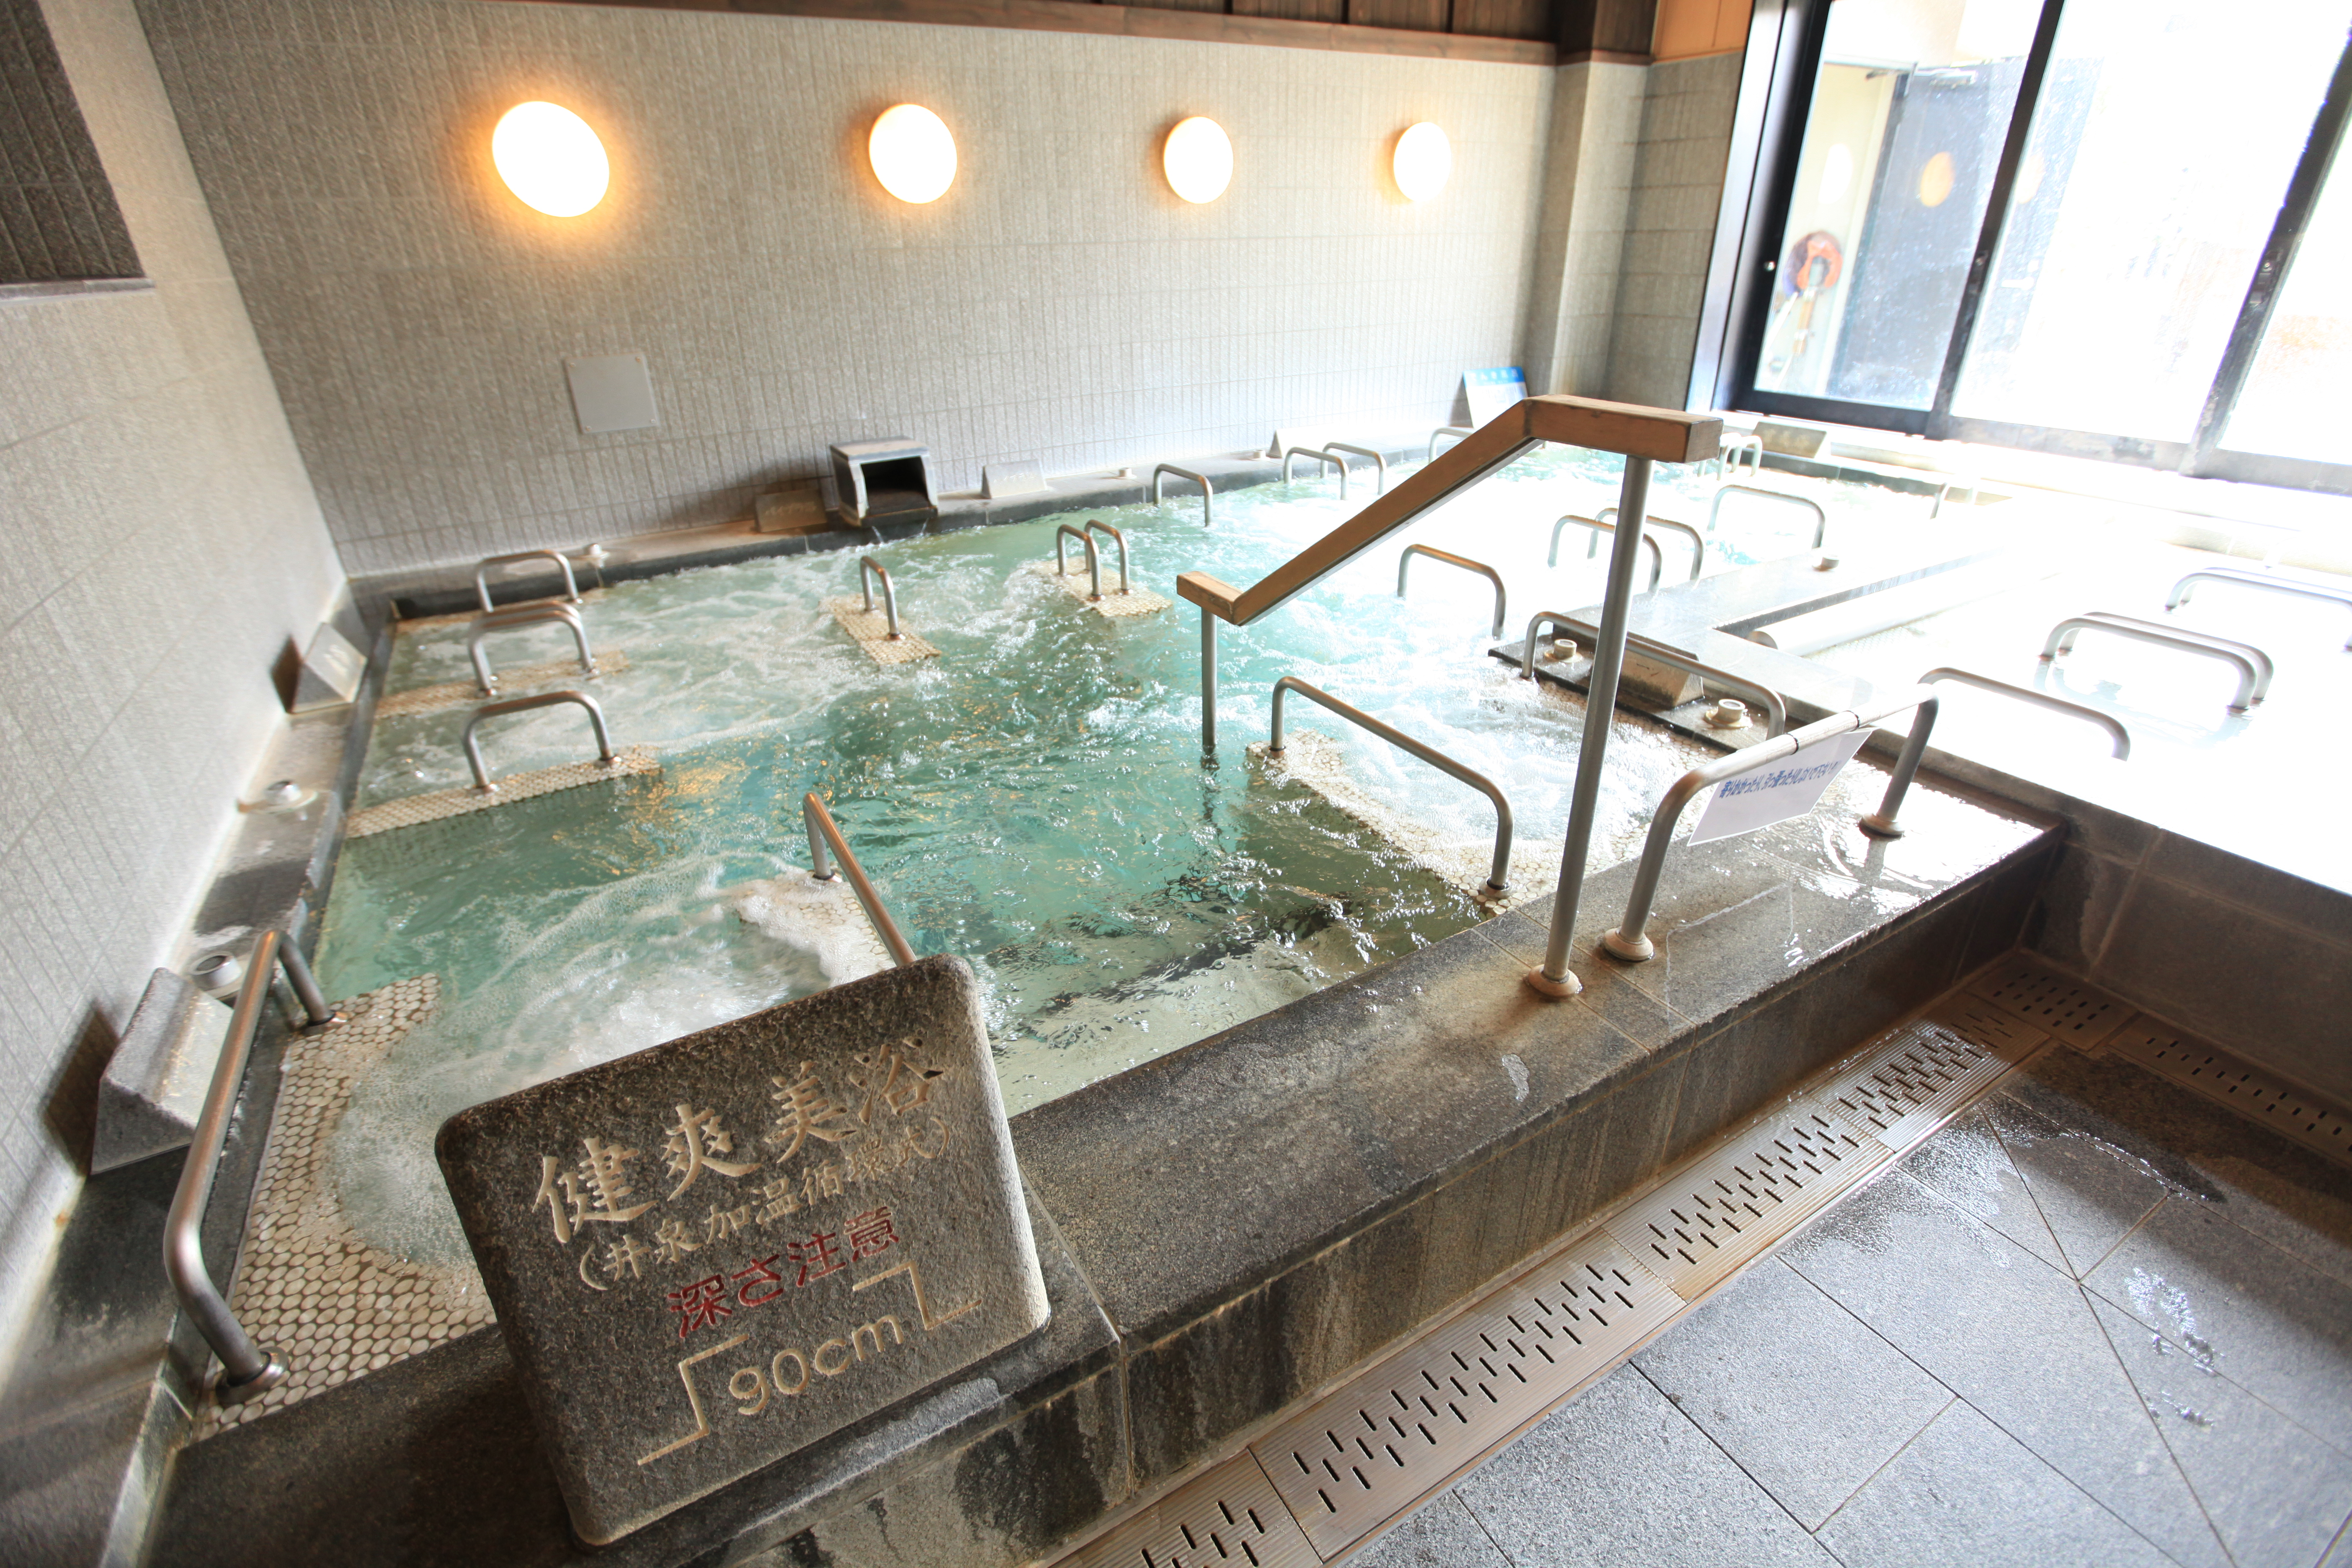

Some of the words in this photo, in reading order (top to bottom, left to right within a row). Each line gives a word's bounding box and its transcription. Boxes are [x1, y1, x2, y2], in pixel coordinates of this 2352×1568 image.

[532, 1036, 944, 1243] 健爽美浴
[668, 1206, 899, 1338] 深さ注意
[729, 1314, 903, 1416] 90cm
